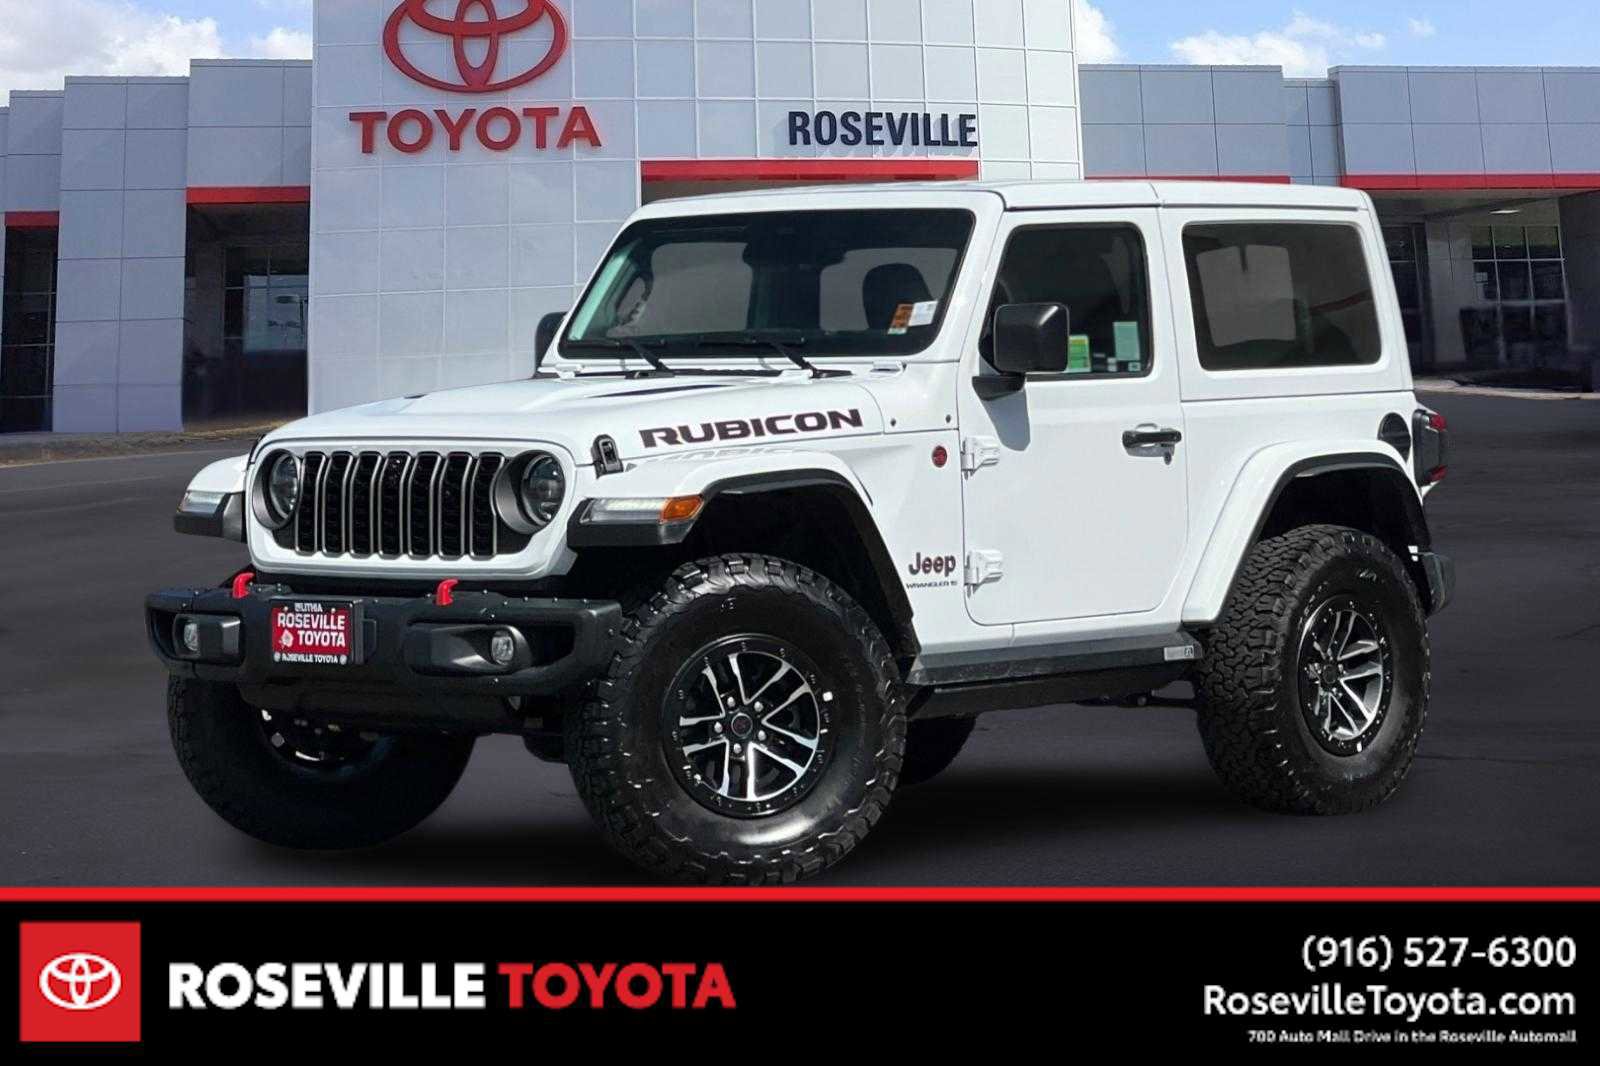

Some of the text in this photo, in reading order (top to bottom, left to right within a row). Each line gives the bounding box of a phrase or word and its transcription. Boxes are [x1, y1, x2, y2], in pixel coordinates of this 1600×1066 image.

[349, 106, 602, 153] TOYOTA
[788, 110, 978, 147] ROSEVILLE
[639, 408, 863, 448] RUBICON
[908, 551, 957, 577] Jeep
[277, 612, 346, 630] ROSEVILLE
[297, 630, 346, 648] TOYOTA
[282, 653, 338, 664] ROSEVILLE TOYOTA
